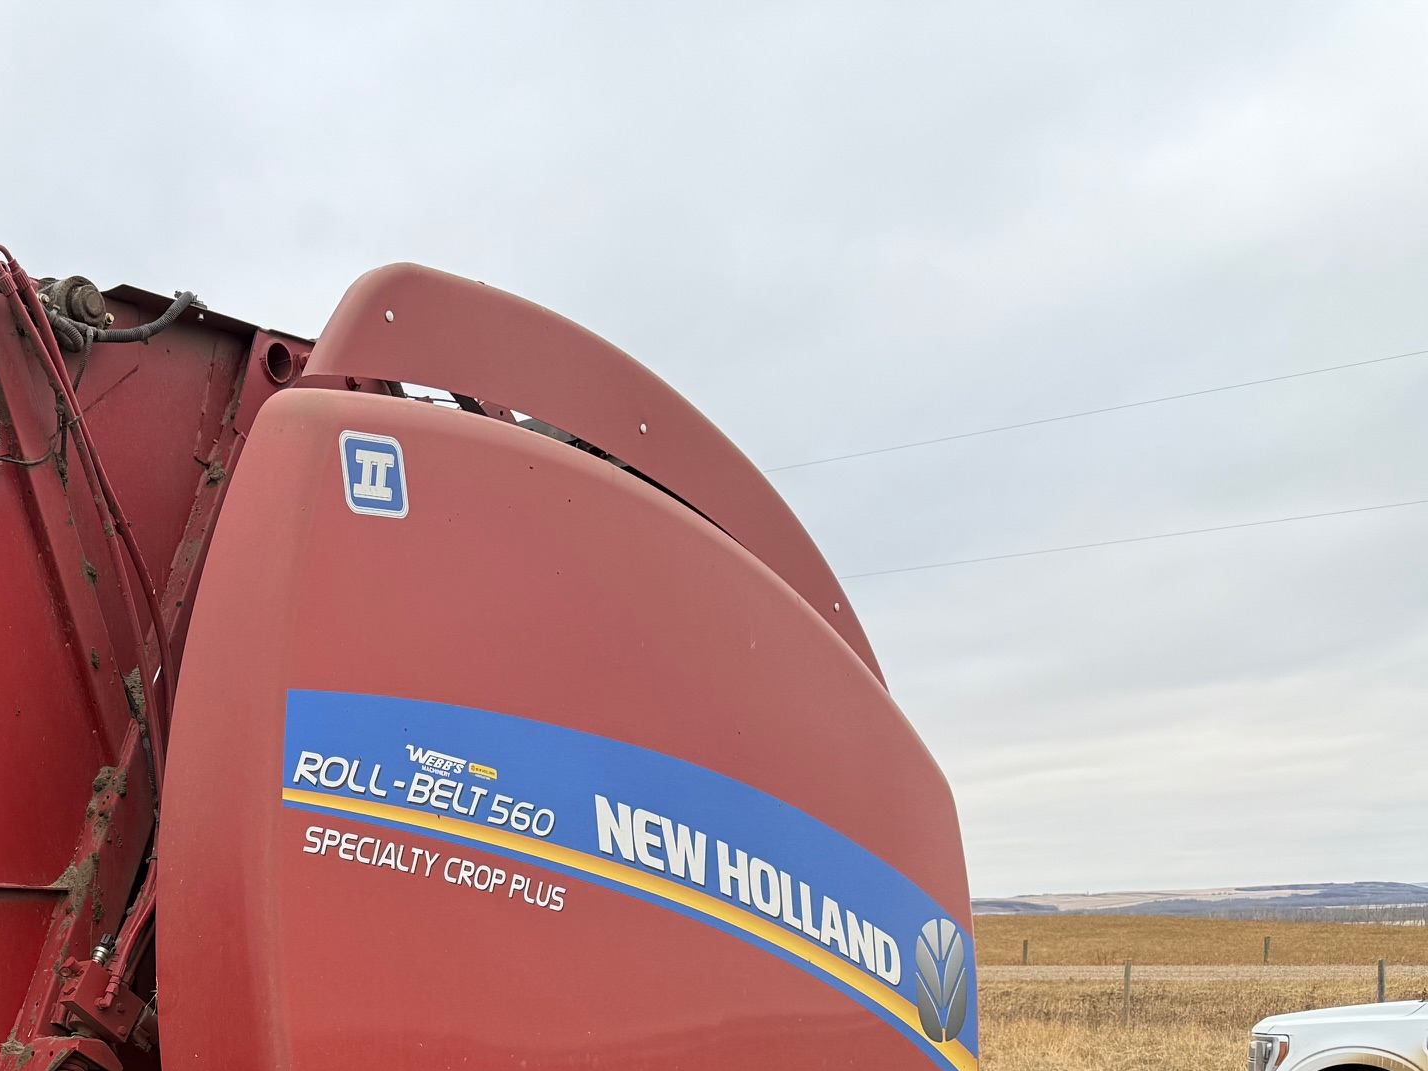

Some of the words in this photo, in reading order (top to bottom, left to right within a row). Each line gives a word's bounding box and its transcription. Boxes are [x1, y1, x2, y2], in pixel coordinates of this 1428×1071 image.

[487, 793, 555, 837] 560
[302, 826, 440, 877] SPECIALTY
[443, 857, 507, 892] CROP
[508, 873, 567, 912] PLUS
[594, 793, 707, 887] NEW
[715, 839, 902, 987] HOLLAND
